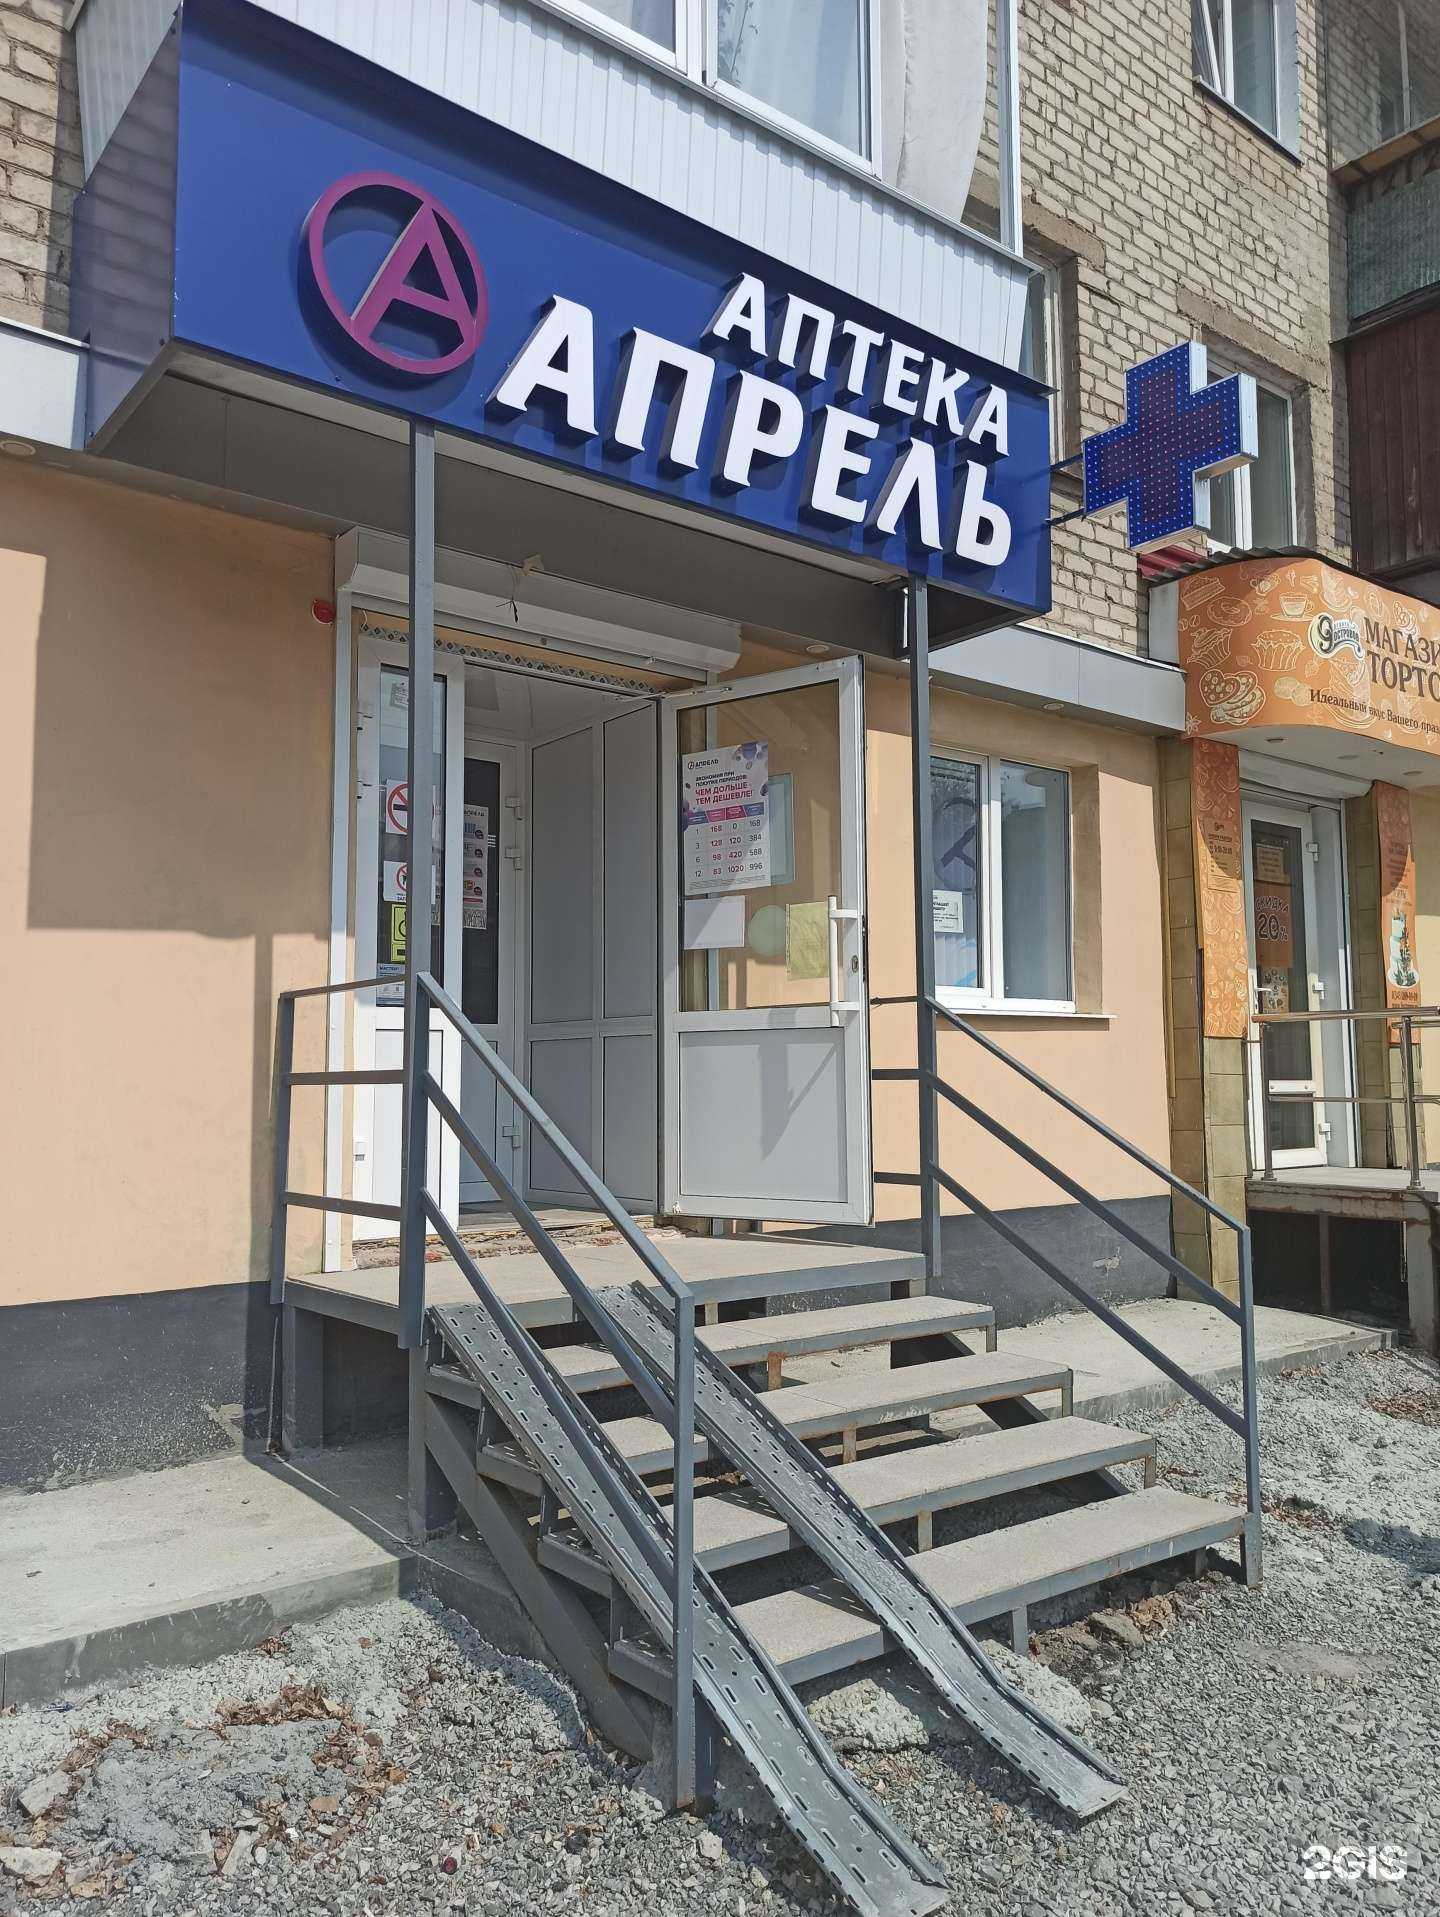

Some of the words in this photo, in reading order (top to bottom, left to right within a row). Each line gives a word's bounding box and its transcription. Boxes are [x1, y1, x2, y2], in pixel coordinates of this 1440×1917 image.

[710, 272, 1010, 457] АПТЕКА
[496, 294, 1012, 567] АПРЕЛЬ
[1310, 689, 1367, 713] Идеальный
[1369, 706, 1386, 719] вкус
[1387, 709, 1419, 729] Вашего
[695, 788, 711, 797] ЧЕМ
[695, 796, 711, 805] ТЕМ
[713, 790, 753, 804] ДЕШЕВЛЕ!
[732, 822, 738, 830] 0
[749, 819, 761, 827] 168
[695, 842, 700, 850] 3
[729, 836, 742, 844] 120
[749, 833, 762, 842] 384
[728, 850, 743, 859] 420
[749, 847, 762, 856] 588
[694, 870, 702, 878] 12
[727, 864, 744, 873] 1020
